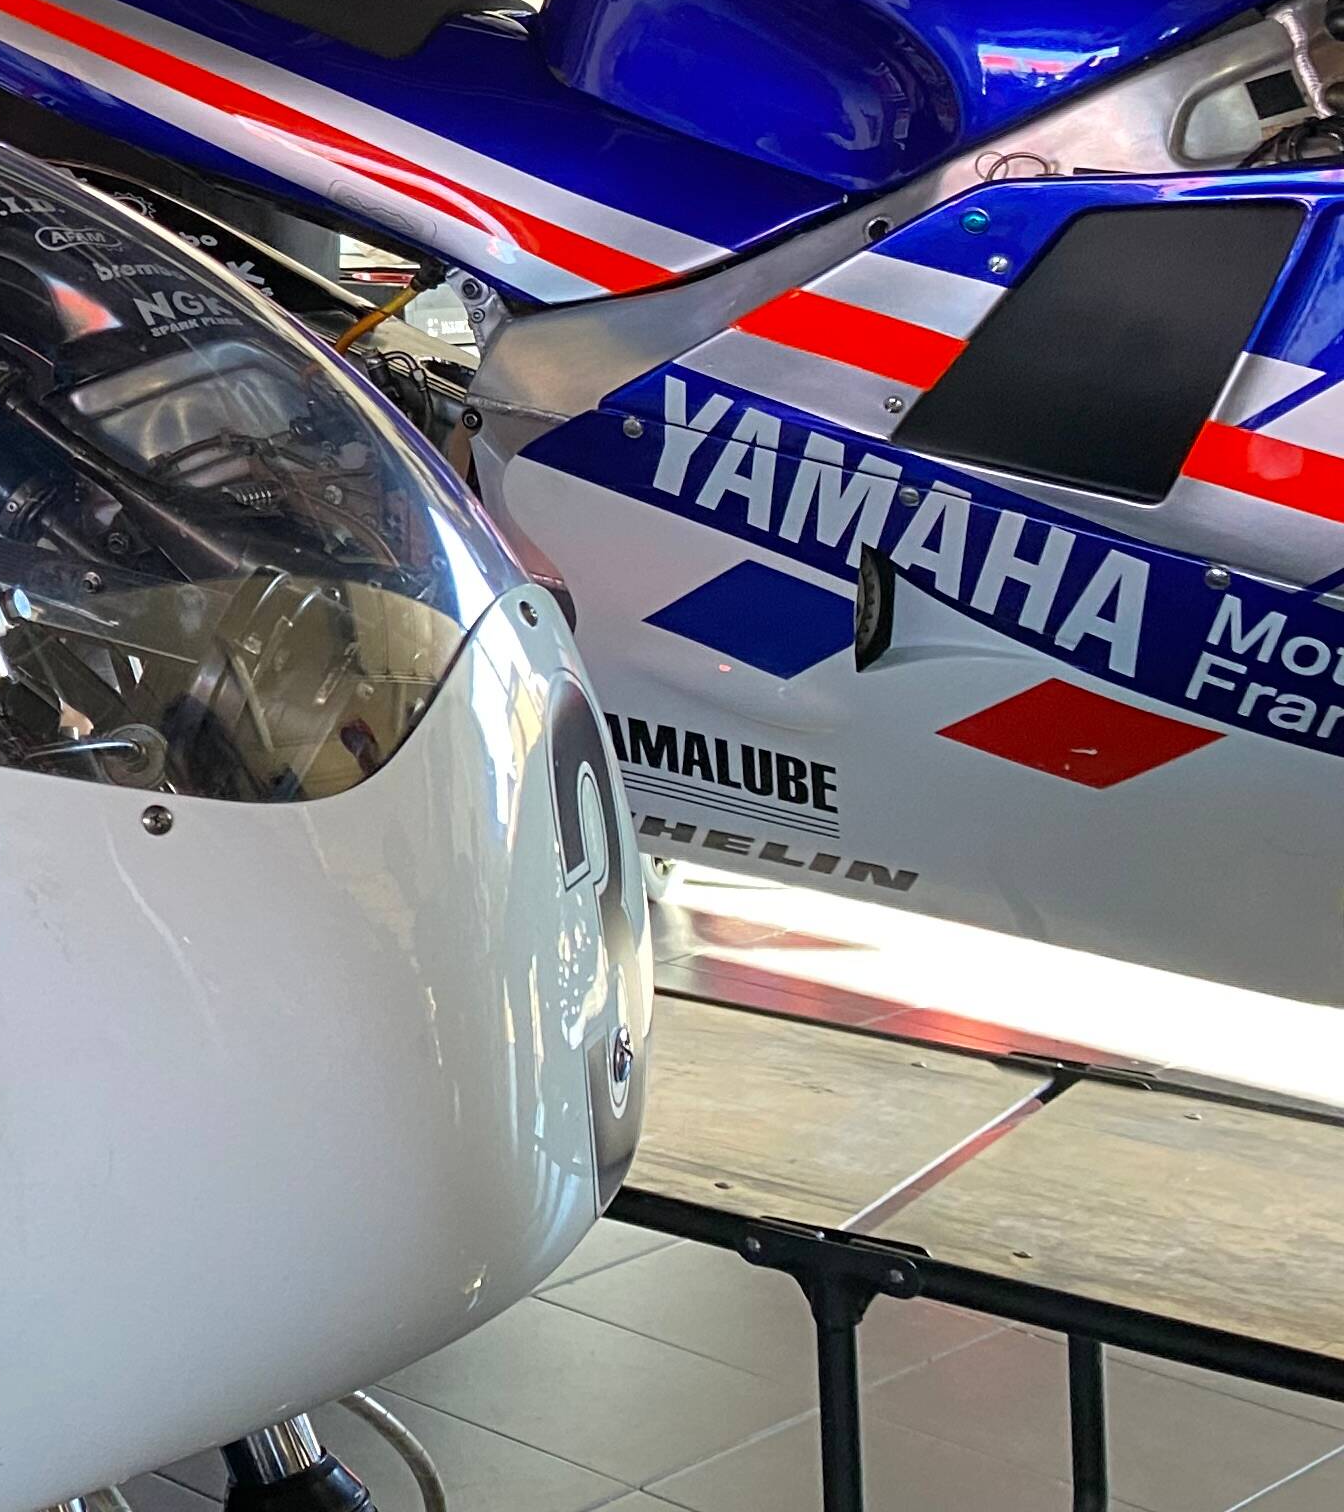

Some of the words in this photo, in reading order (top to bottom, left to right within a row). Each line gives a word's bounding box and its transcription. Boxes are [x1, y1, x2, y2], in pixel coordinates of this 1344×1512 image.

[50, 229, 108, 246] AFAM
[133, 290, 234, 327] NGK
[150, 319, 201, 338] SPARK
[653, 374, 1151, 679] YAMAHA
[630, 811, 920, 892] HELIN
